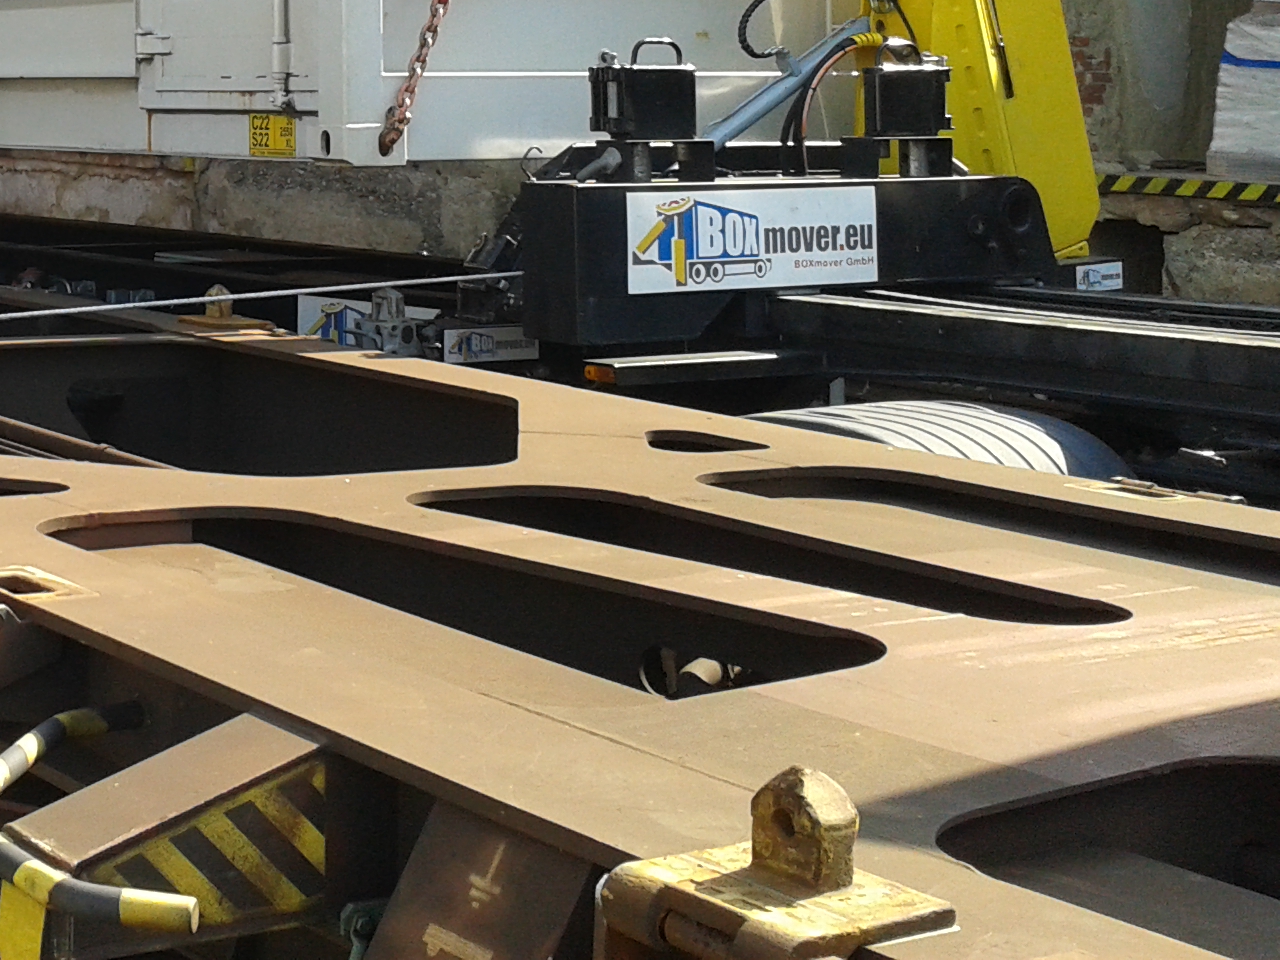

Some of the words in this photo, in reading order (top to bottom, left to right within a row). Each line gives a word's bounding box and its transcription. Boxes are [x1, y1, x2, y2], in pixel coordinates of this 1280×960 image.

[252, 115, 270, 130] C22
[251, 131, 270, 148] S22
[794, 259, 844, 269] BOXmover
[846, 256, 875, 267] GmbH
